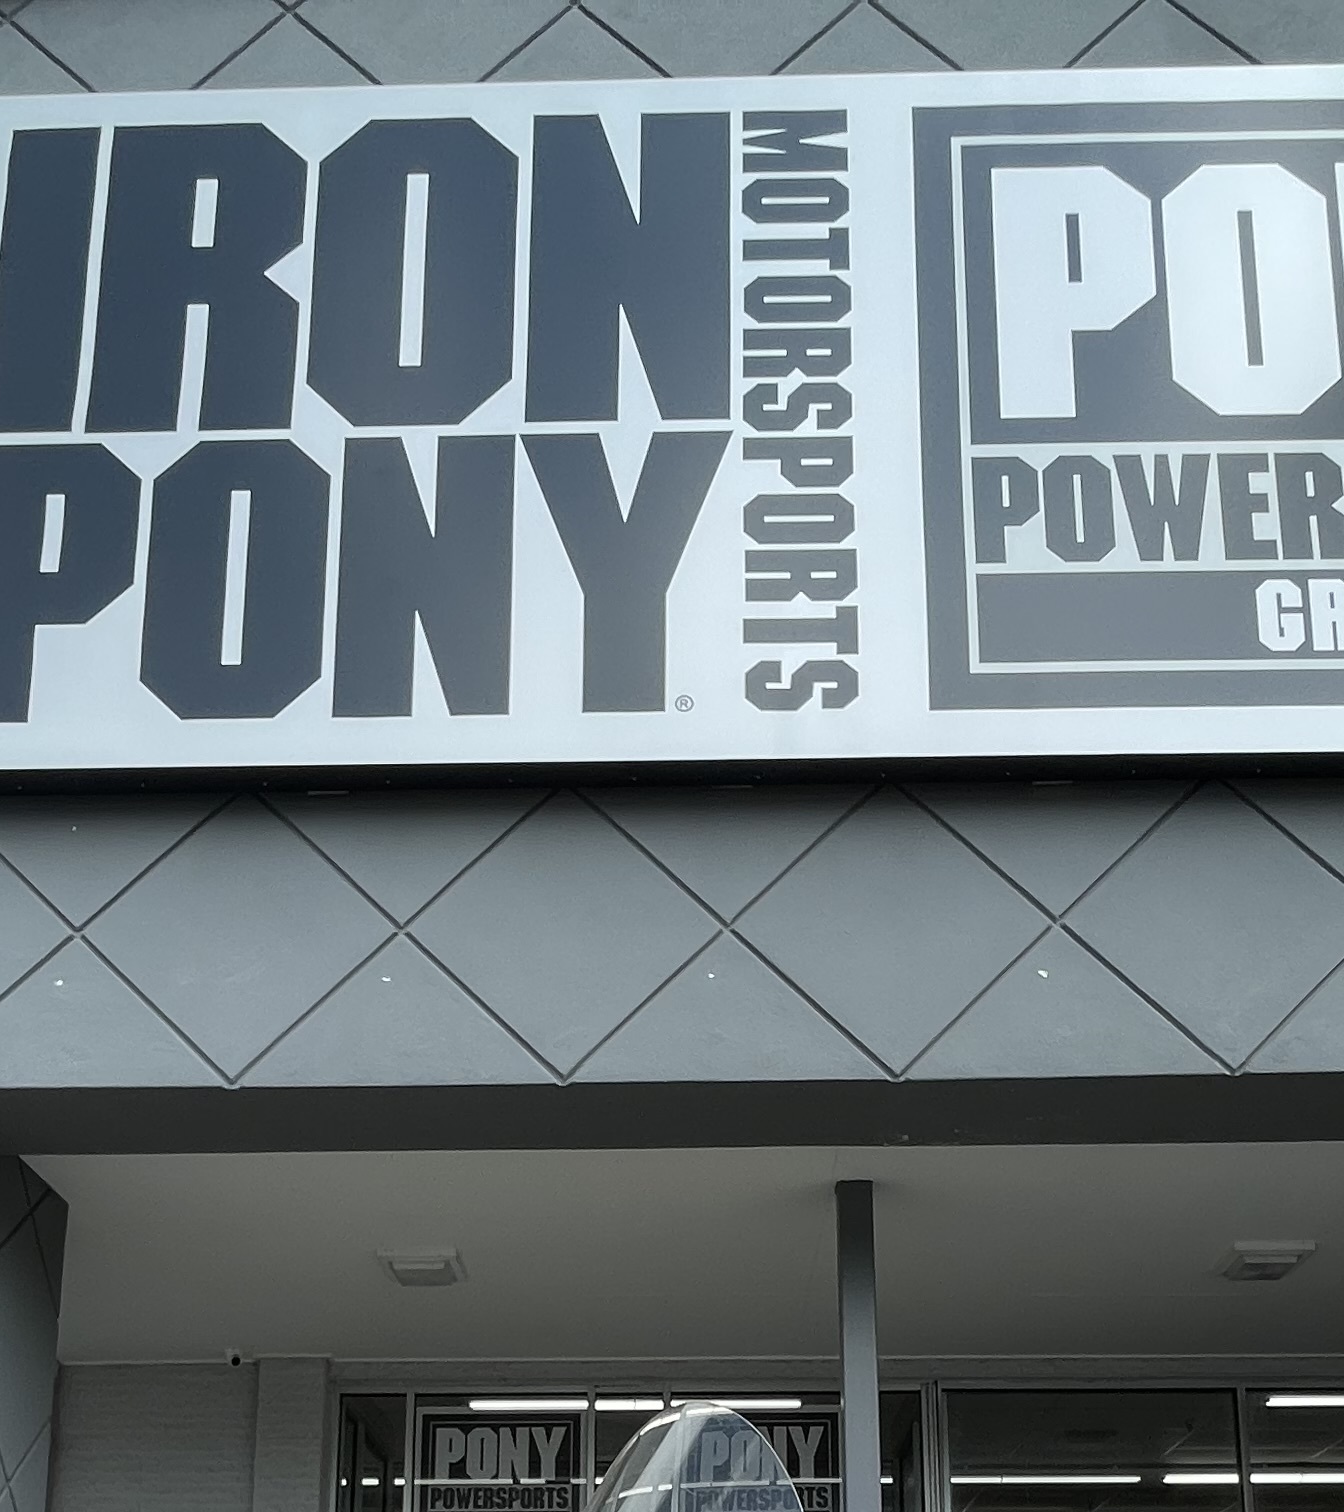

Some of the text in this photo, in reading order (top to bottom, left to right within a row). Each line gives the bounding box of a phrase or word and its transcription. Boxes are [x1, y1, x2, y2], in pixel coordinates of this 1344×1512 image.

[741, 109, 859, 711] MOTORSPORTS
[435, 1426, 568, 1480] PONY
[699, 1425, 825, 1483] PONY
[429, 1486, 569, 1510] POWERSPORTS
[694, 1486, 829, 1512] POWERSPORTS
